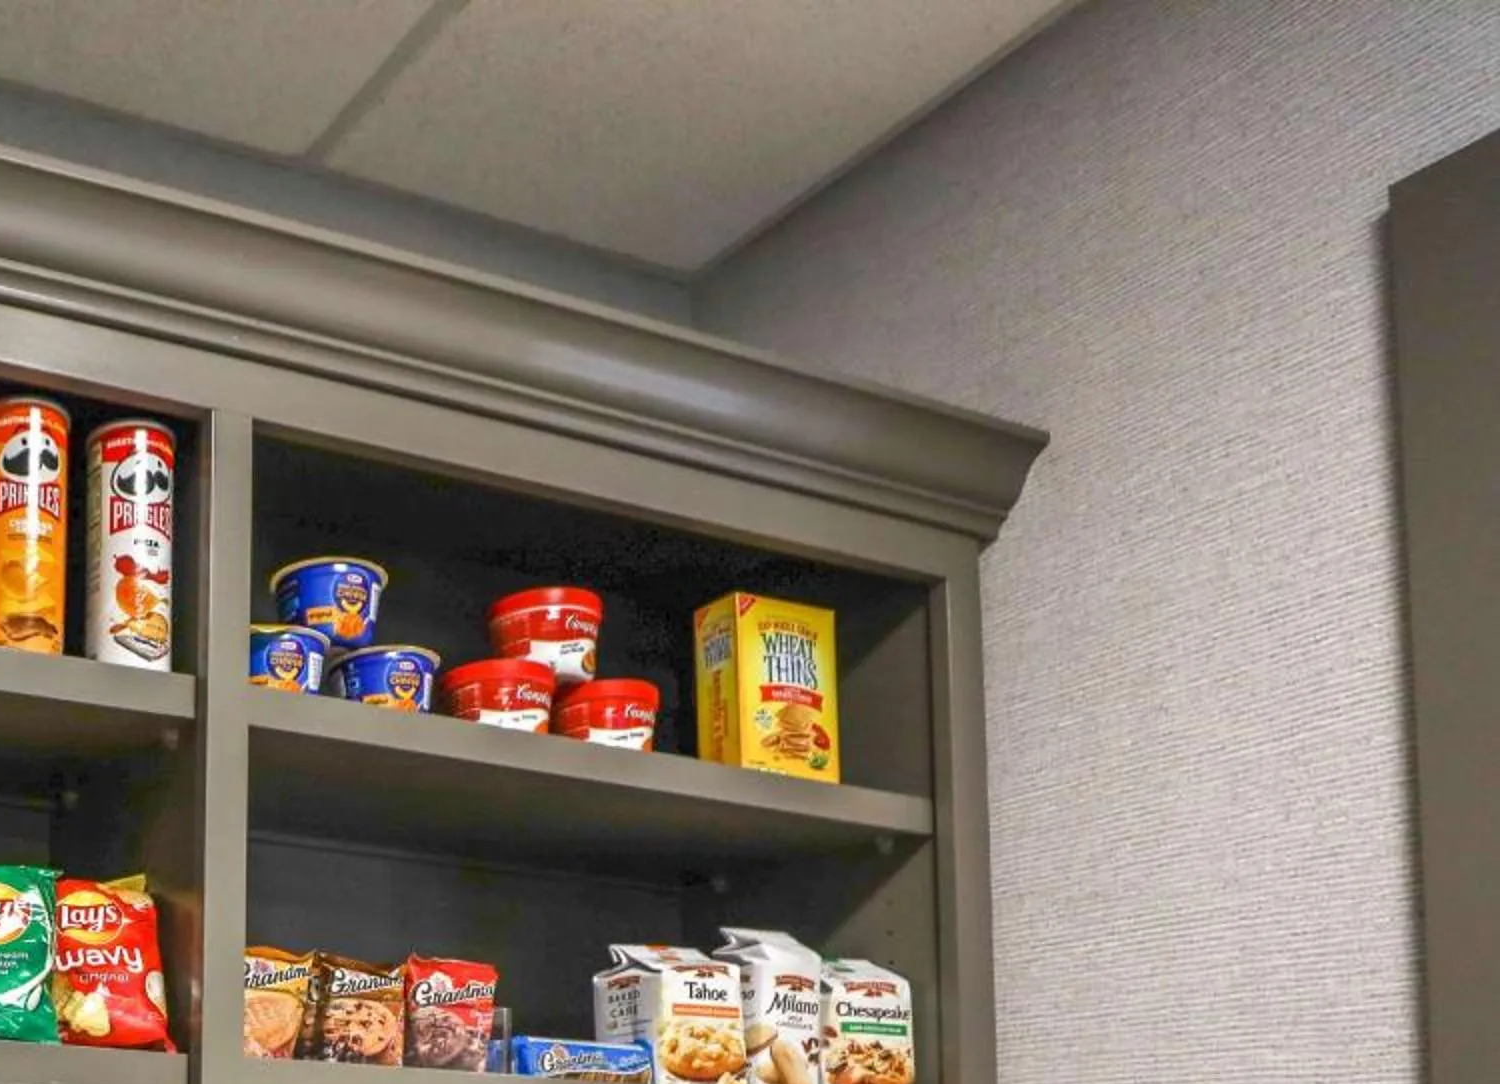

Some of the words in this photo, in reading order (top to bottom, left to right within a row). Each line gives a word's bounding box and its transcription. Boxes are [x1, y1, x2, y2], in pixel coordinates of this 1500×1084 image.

[0, 482, 61, 518] PRINLES
[113, 500, 171, 537] PRIGLES
[760, 631, 817, 660] WHEAT
[763, 654, 819, 690] THINS
[56, 946, 144, 973] wavy
[684, 981, 728, 1001] Tahoe
[766, 993, 819, 1015] Milano
[836, 1002, 911, 1022] Chesapeake
